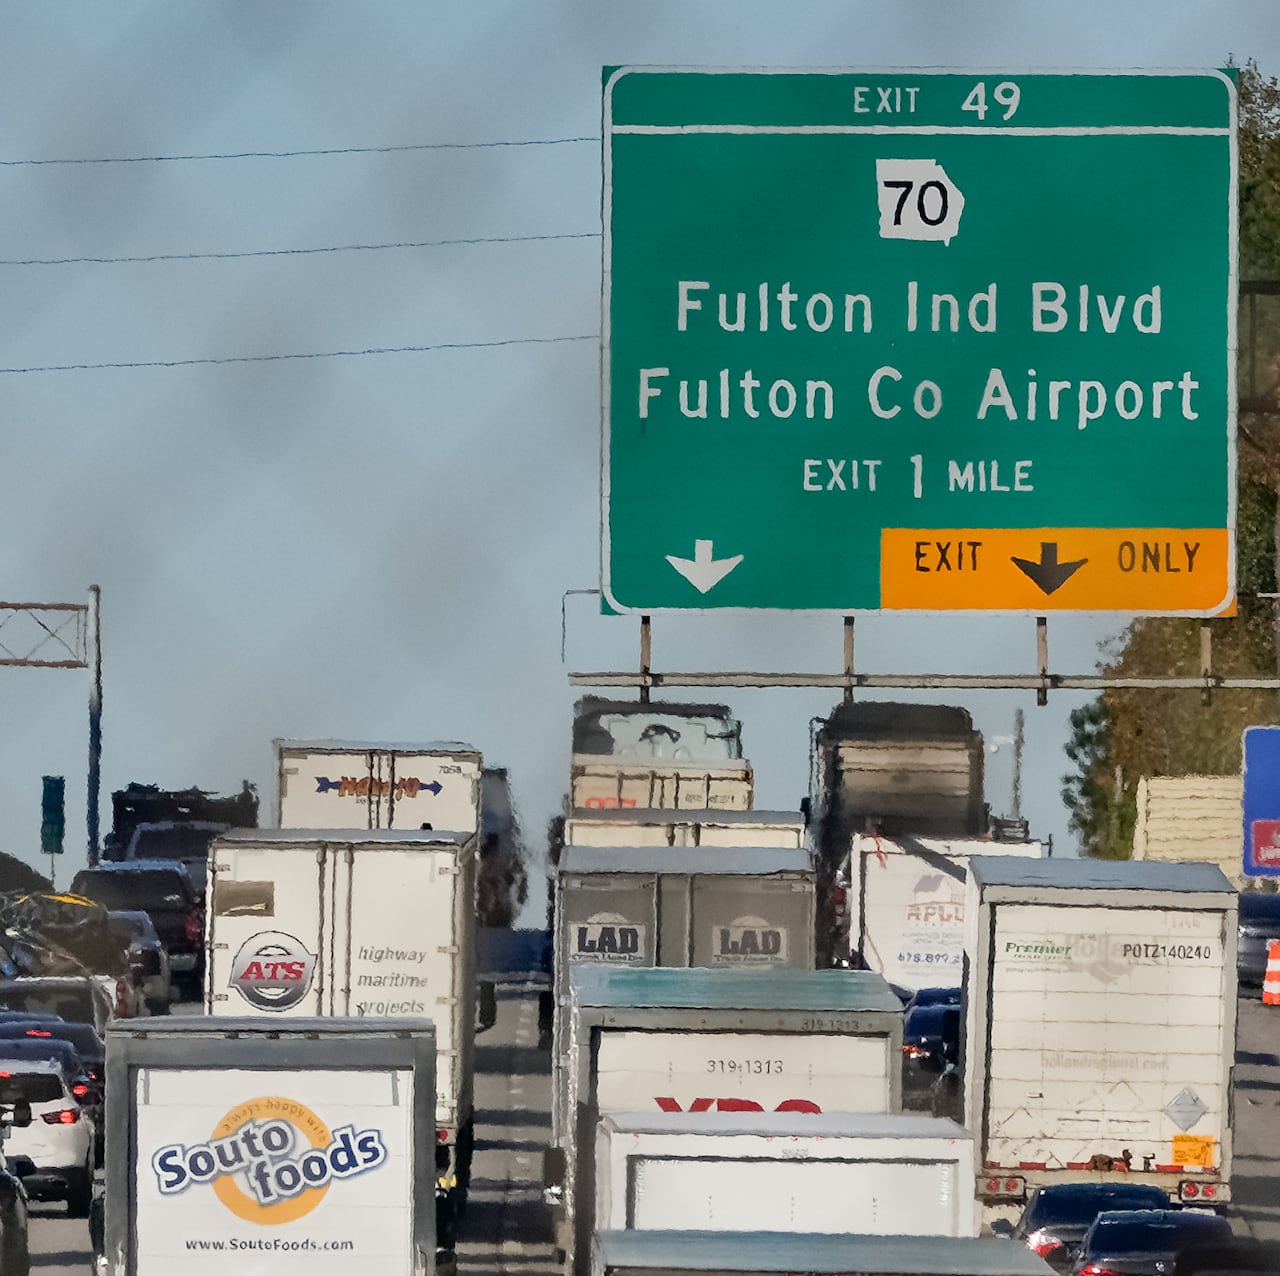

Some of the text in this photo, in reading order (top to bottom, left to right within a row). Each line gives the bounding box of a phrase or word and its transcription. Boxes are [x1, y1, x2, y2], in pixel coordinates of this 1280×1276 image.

[852, 82, 1021, 121] EXIT 49
[883, 179, 949, 227] 70
[677, 281, 1162, 335] Fulton Ind Blvd
[638, 366, 1200, 431] Fulton Co Airport
[803, 454, 1034, 499] EXIT 1 MILE
[914, 541, 1202, 574] EXIT ONLY
[357, 945, 428, 963] highway
[577, 926, 640, 954] LAD
[720, 928, 782, 956] LAD
[241, 961, 308, 981] ATS
[356, 972, 428, 989] maritime
[157, 1125, 290, 1189] Souto
[252, 1132, 382, 1199] foods
